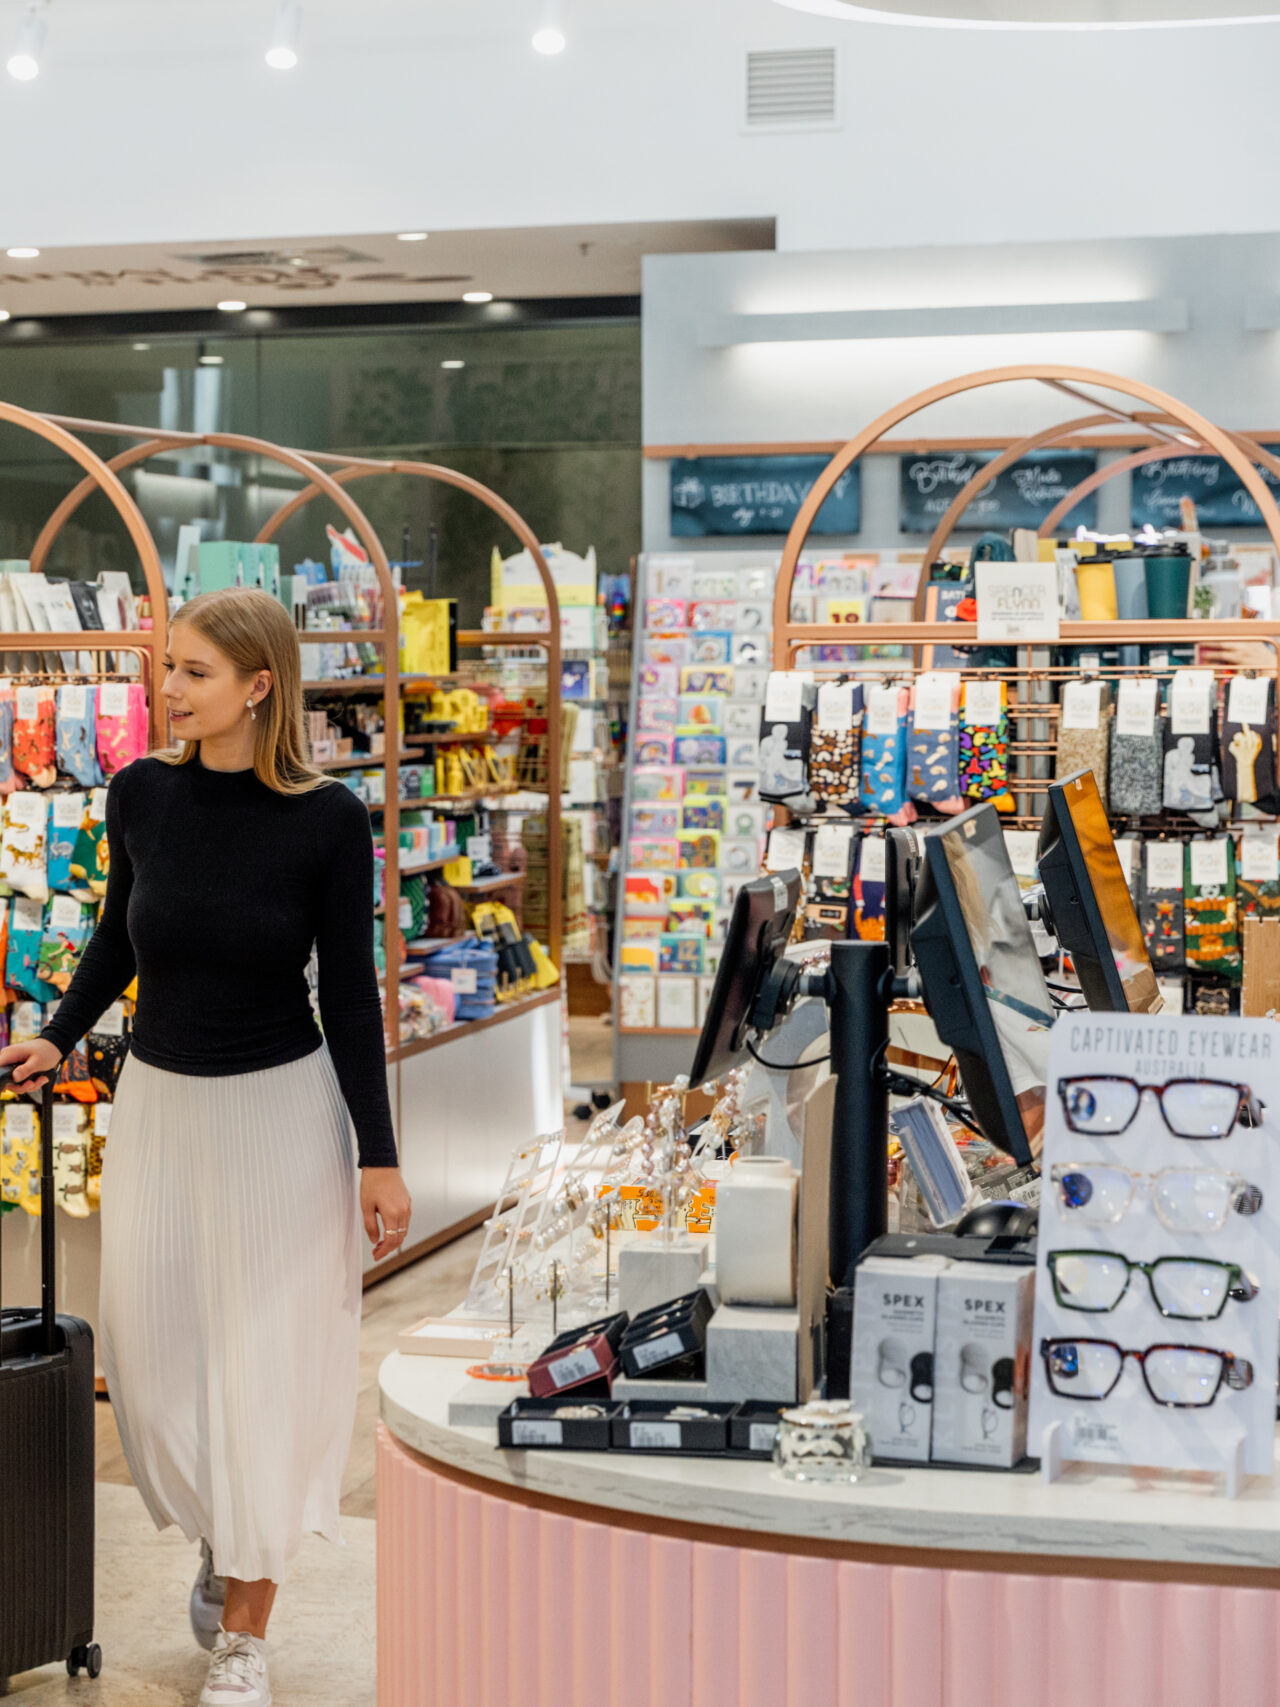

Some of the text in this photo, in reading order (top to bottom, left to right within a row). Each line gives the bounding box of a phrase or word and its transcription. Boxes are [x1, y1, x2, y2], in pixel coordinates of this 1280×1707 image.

[1070, 1026, 1273, 1059] CAPTIVATED EYEWEAR
[1134, 1059, 1207, 1079] AUSTRALIA
[882, 1293, 925, 1309] SPEX
[963, 1298, 1007, 1314] SPEX
